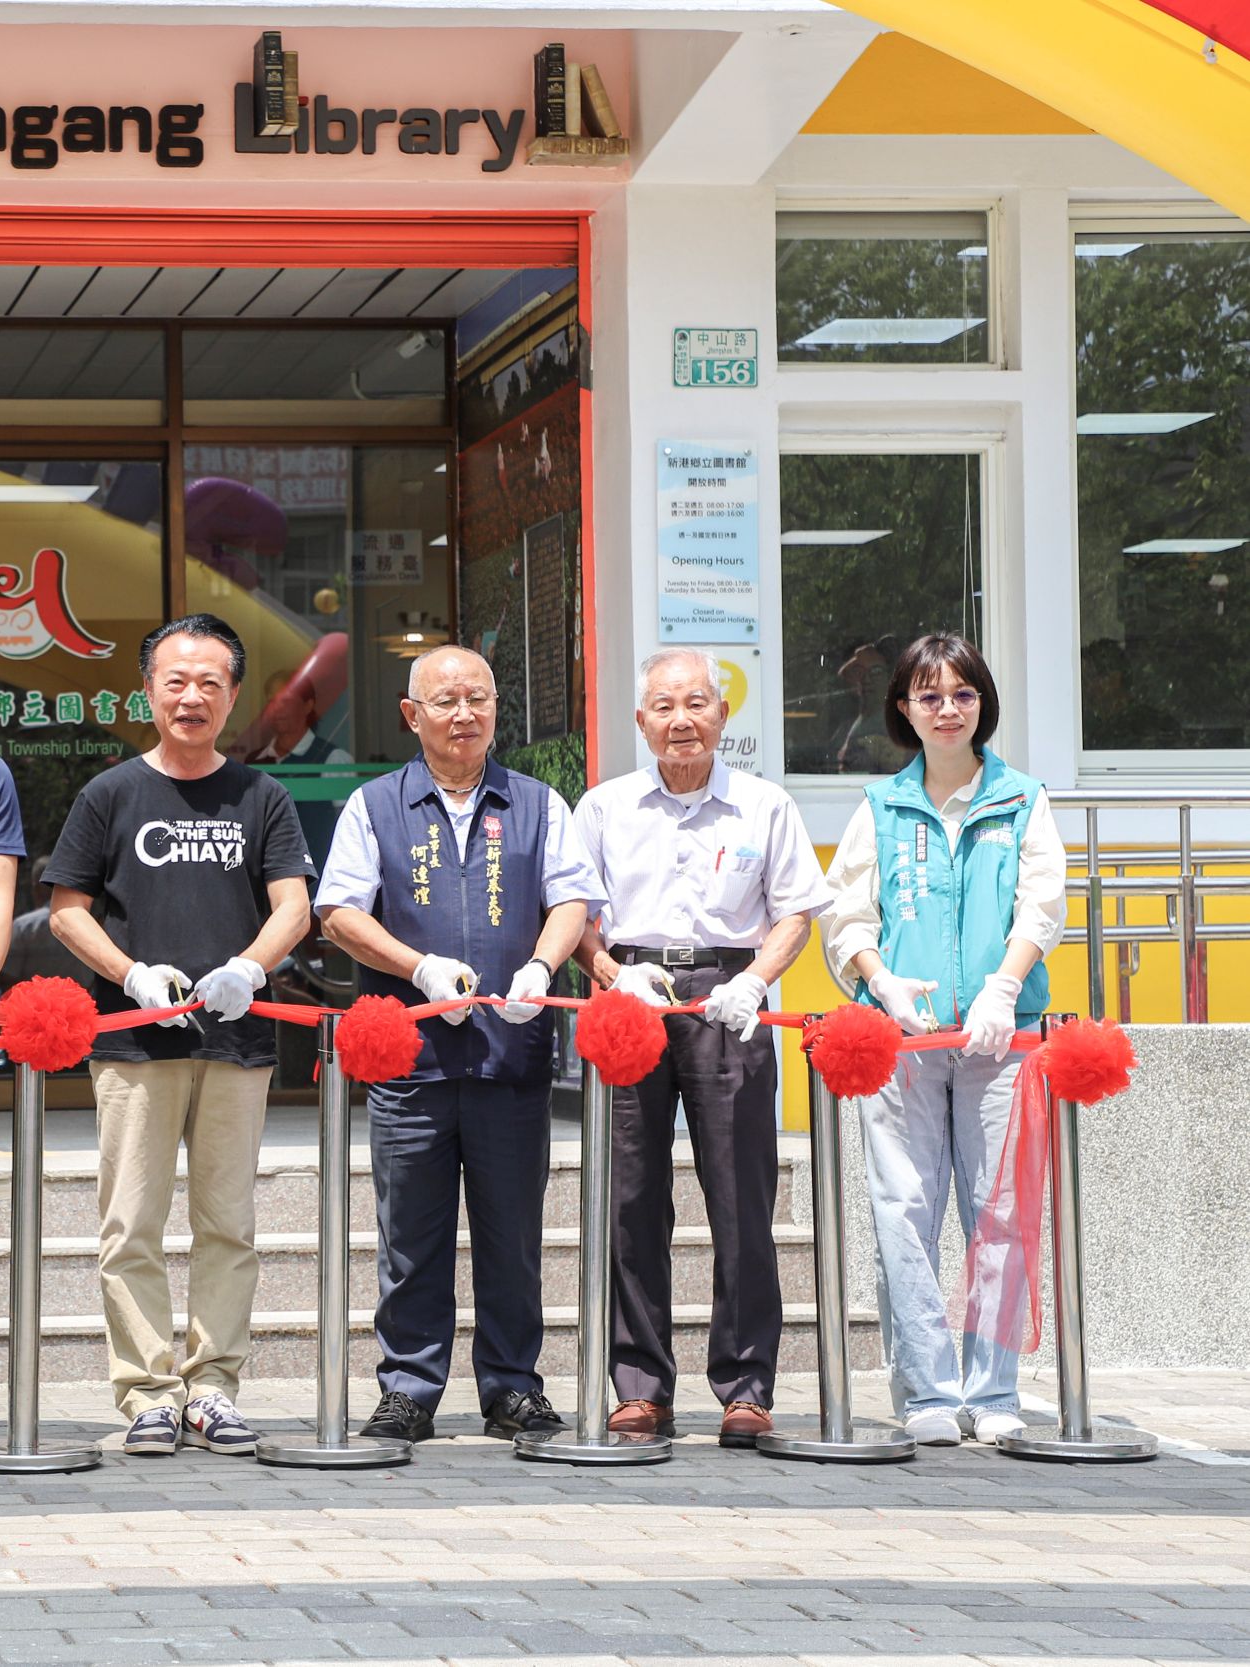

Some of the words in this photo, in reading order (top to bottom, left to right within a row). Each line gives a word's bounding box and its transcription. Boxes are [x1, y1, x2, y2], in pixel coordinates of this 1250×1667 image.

[234, 82, 525, 172] Library
[697, 332, 747, 346] 中山路
[697, 360, 751, 384] 156
[667, 457, 747, 469] 新港鄉立圖書館
[687, 477, 727, 487] 開放時間
[672, 556, 713, 567] Opening
[716, 556, 744, 565] Hours
[664, 587, 689, 595] Saturday
[661, 616, 690, 624] Mondays
[7, 740, 71, 758] Township
[76, 739, 124, 758] Library
[717, 735, 757, 756] 中心
[721, 758, 756, 770] enter
[176, 820, 194, 828] THE
[195, 820, 232, 828] COUNTY
[232, 822, 243, 830] OF
[134, 820, 244, 867] CHIAYI
[177, 828, 208, 841] THE
[211, 828, 246, 846] SUN,
[485, 846, 504, 927] 新港奉天宮
